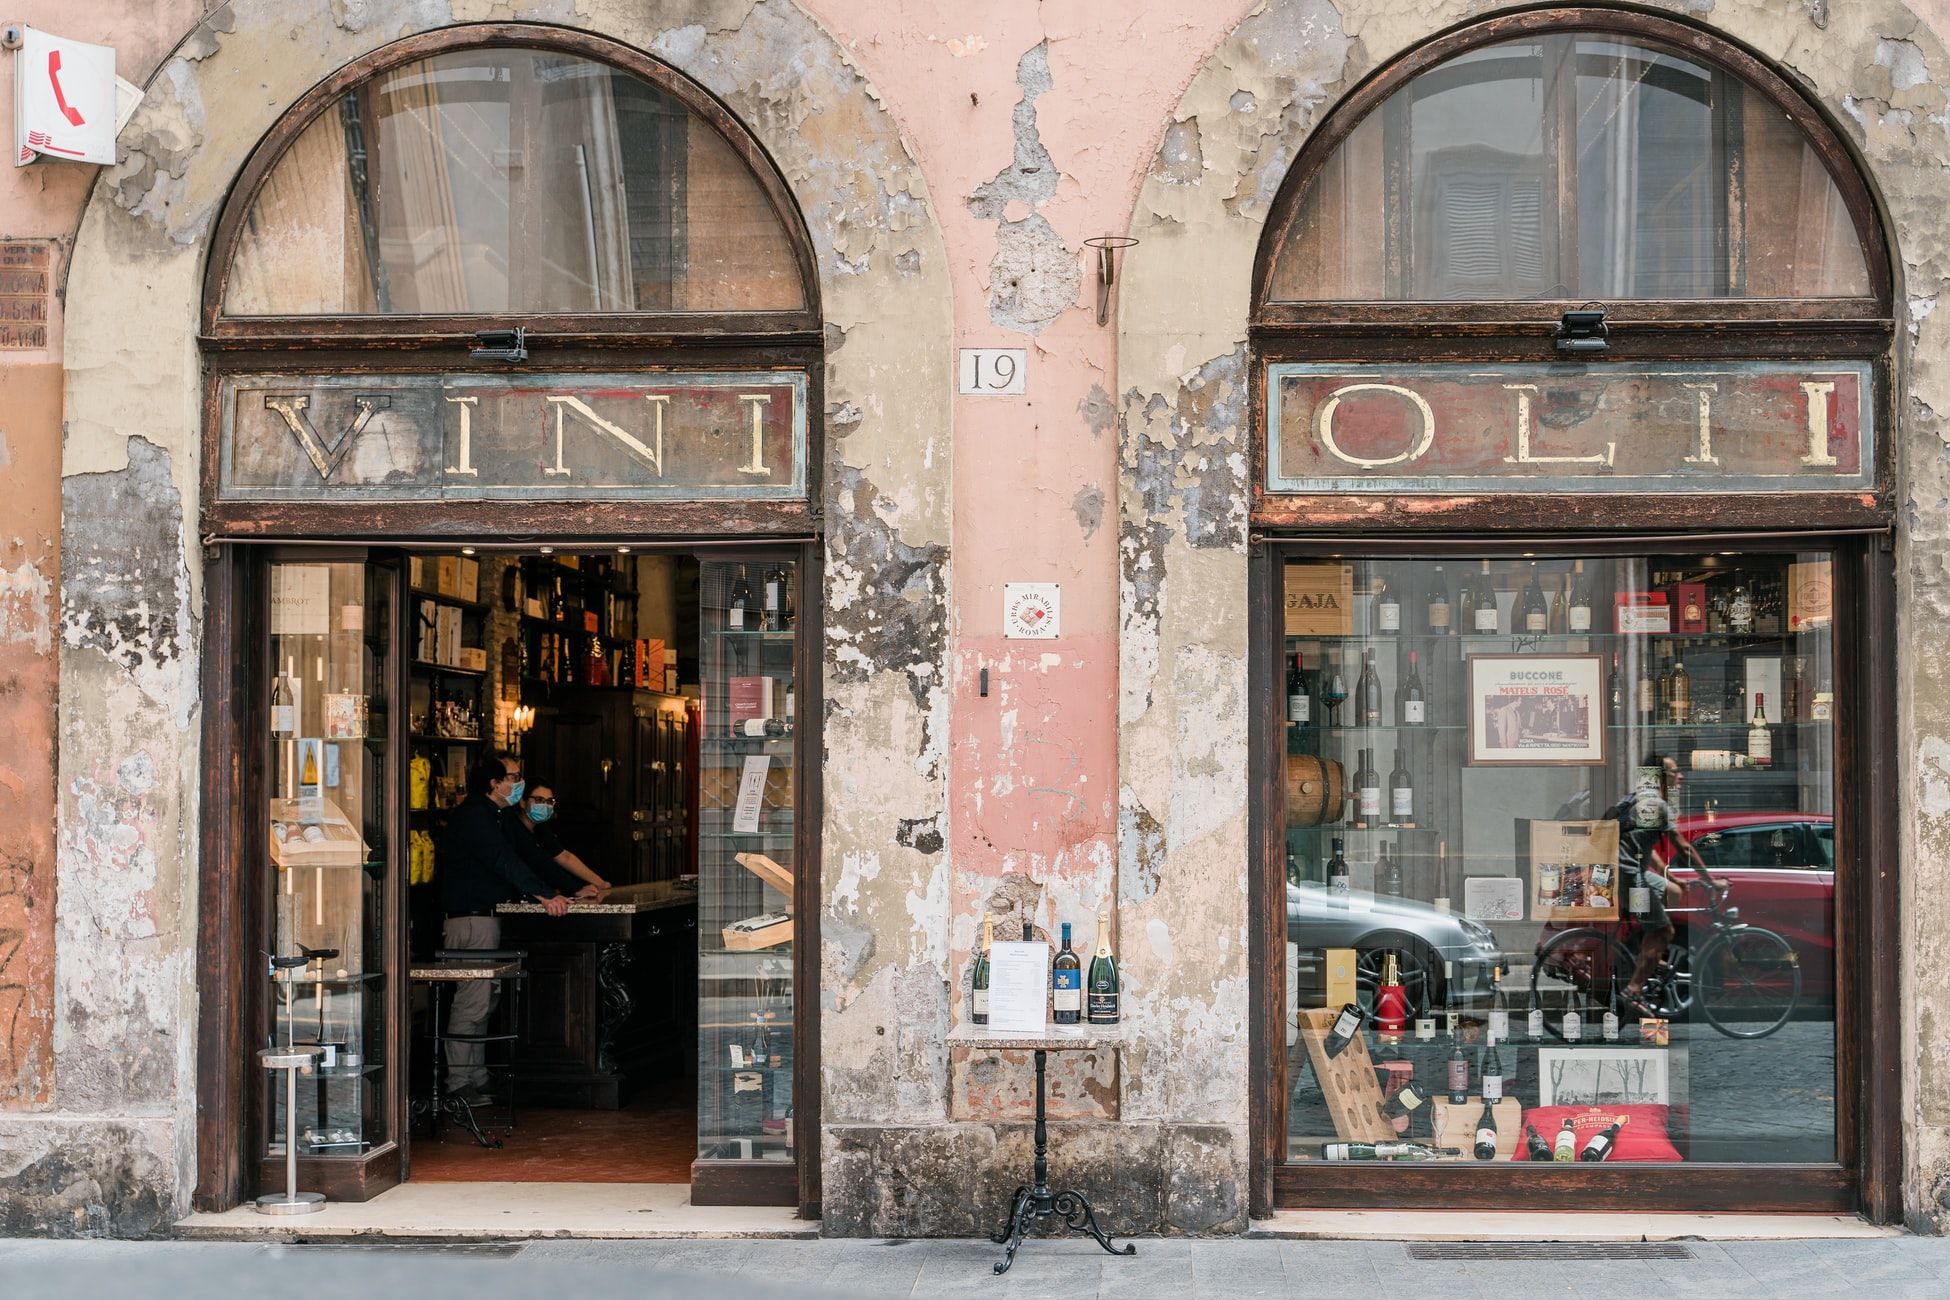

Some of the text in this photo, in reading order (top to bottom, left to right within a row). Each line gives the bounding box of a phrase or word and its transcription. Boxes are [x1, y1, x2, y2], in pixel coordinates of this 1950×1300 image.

[971, 354, 1016, 389] 19
[264, 393, 771, 480] VINI
[1317, 380, 1838, 470] OLII
[1022, 594, 1053, 625] MIRABILIS
[1287, 593, 1340, 609] GAJA
[1019, 627, 1046, 636] ROMA
[1510, 671, 1563, 681] BUCCONE
[1499, 686, 1538, 695] MATEUS
